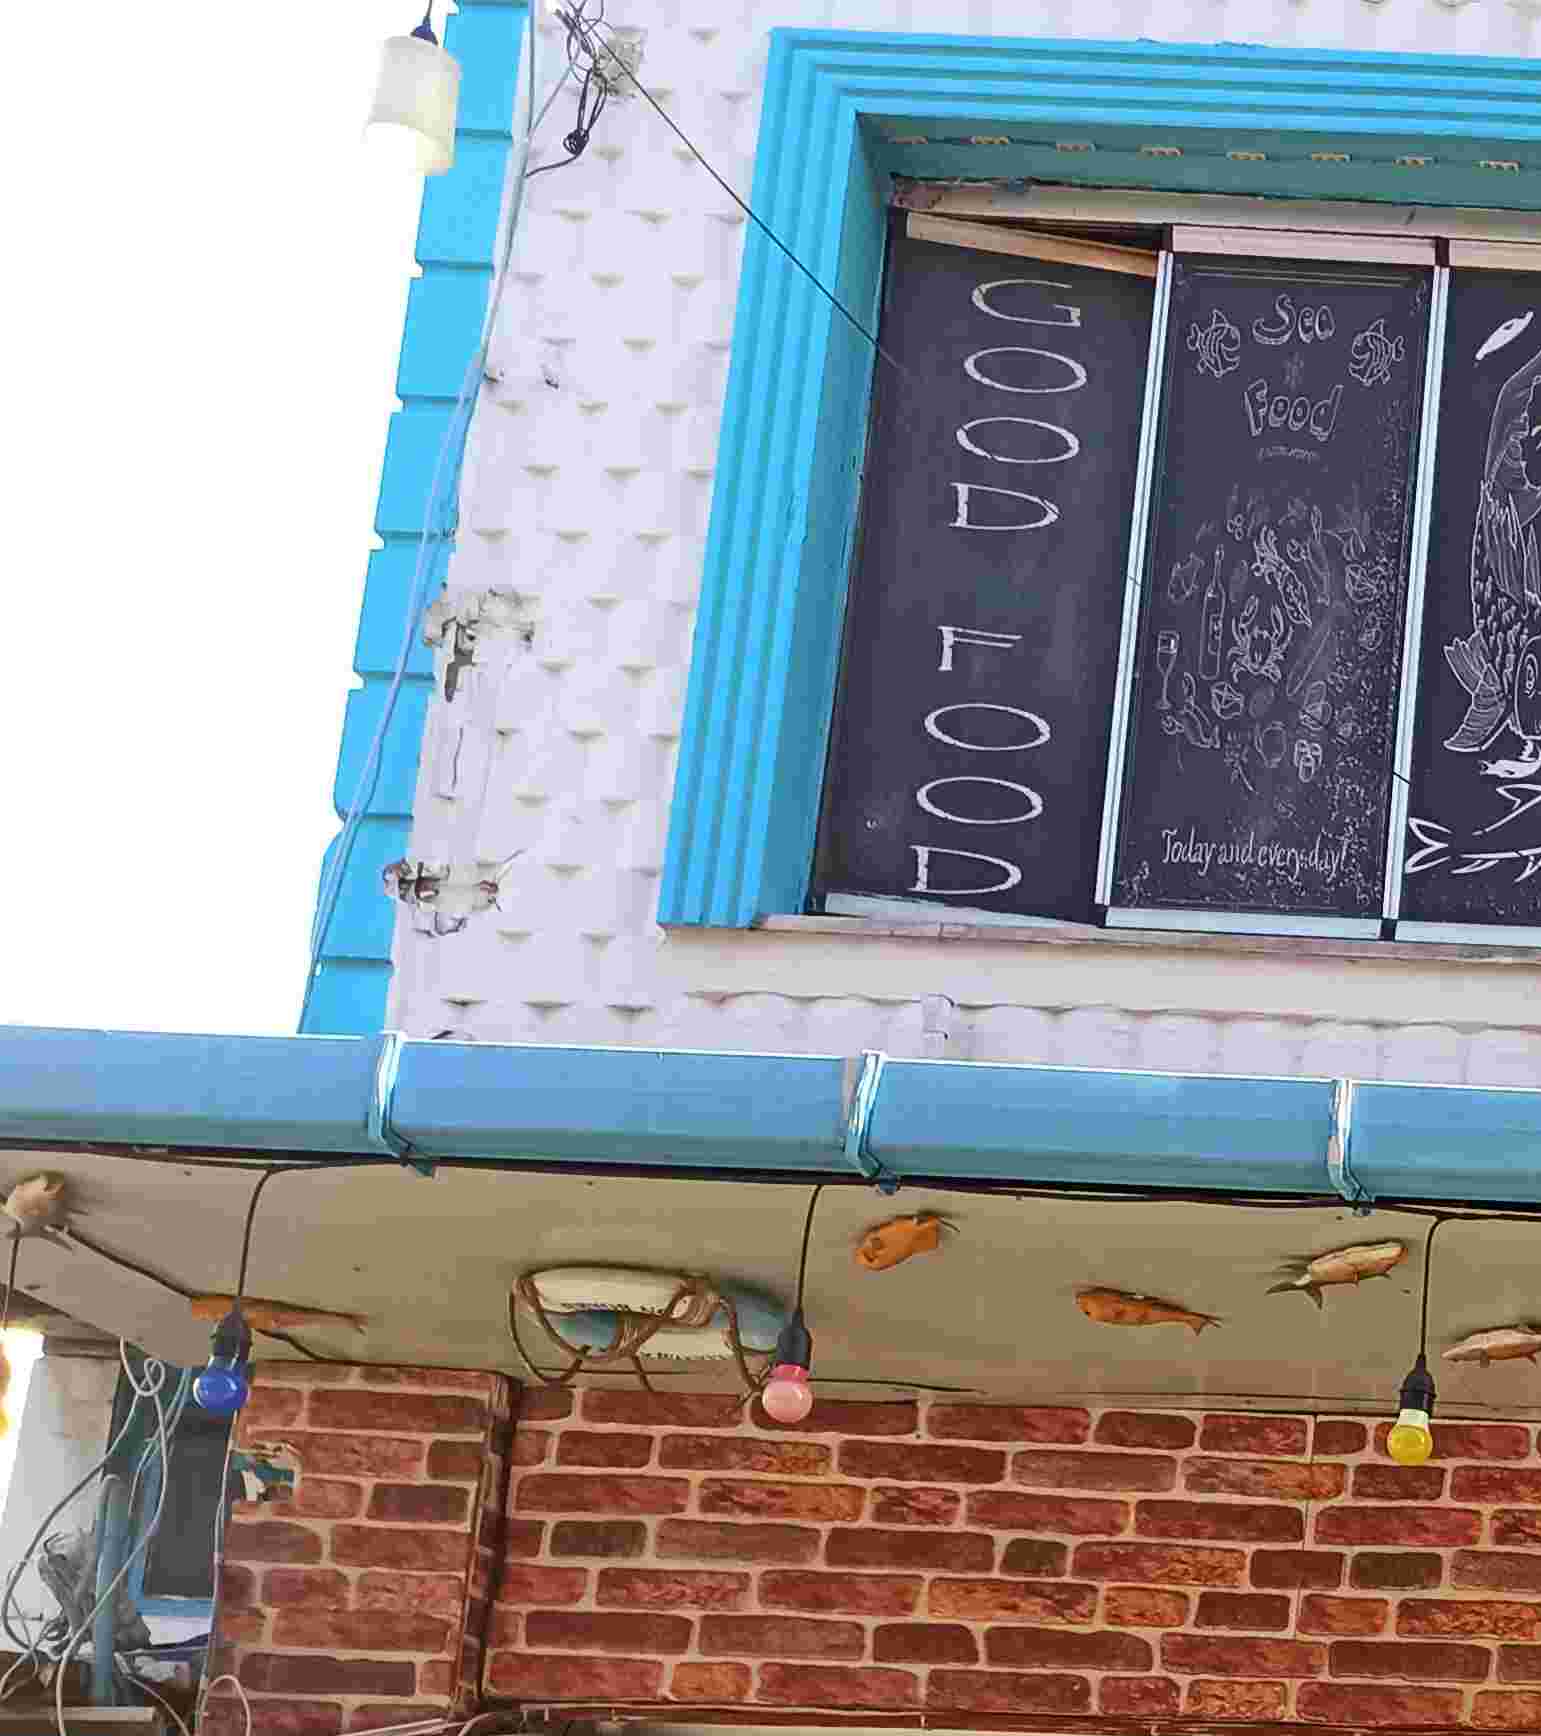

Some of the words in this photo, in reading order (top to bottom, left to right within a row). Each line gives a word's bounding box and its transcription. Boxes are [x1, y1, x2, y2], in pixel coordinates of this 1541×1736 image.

[1252, 293, 1336, 346] Sea
[949, 279, 1087, 531] GOOD
[1243, 378, 1345, 442] Food
[907, 626, 1052, 896] FOOD
[1161, 826, 1216, 877] Today
[1217, 832, 1254, 866] and
